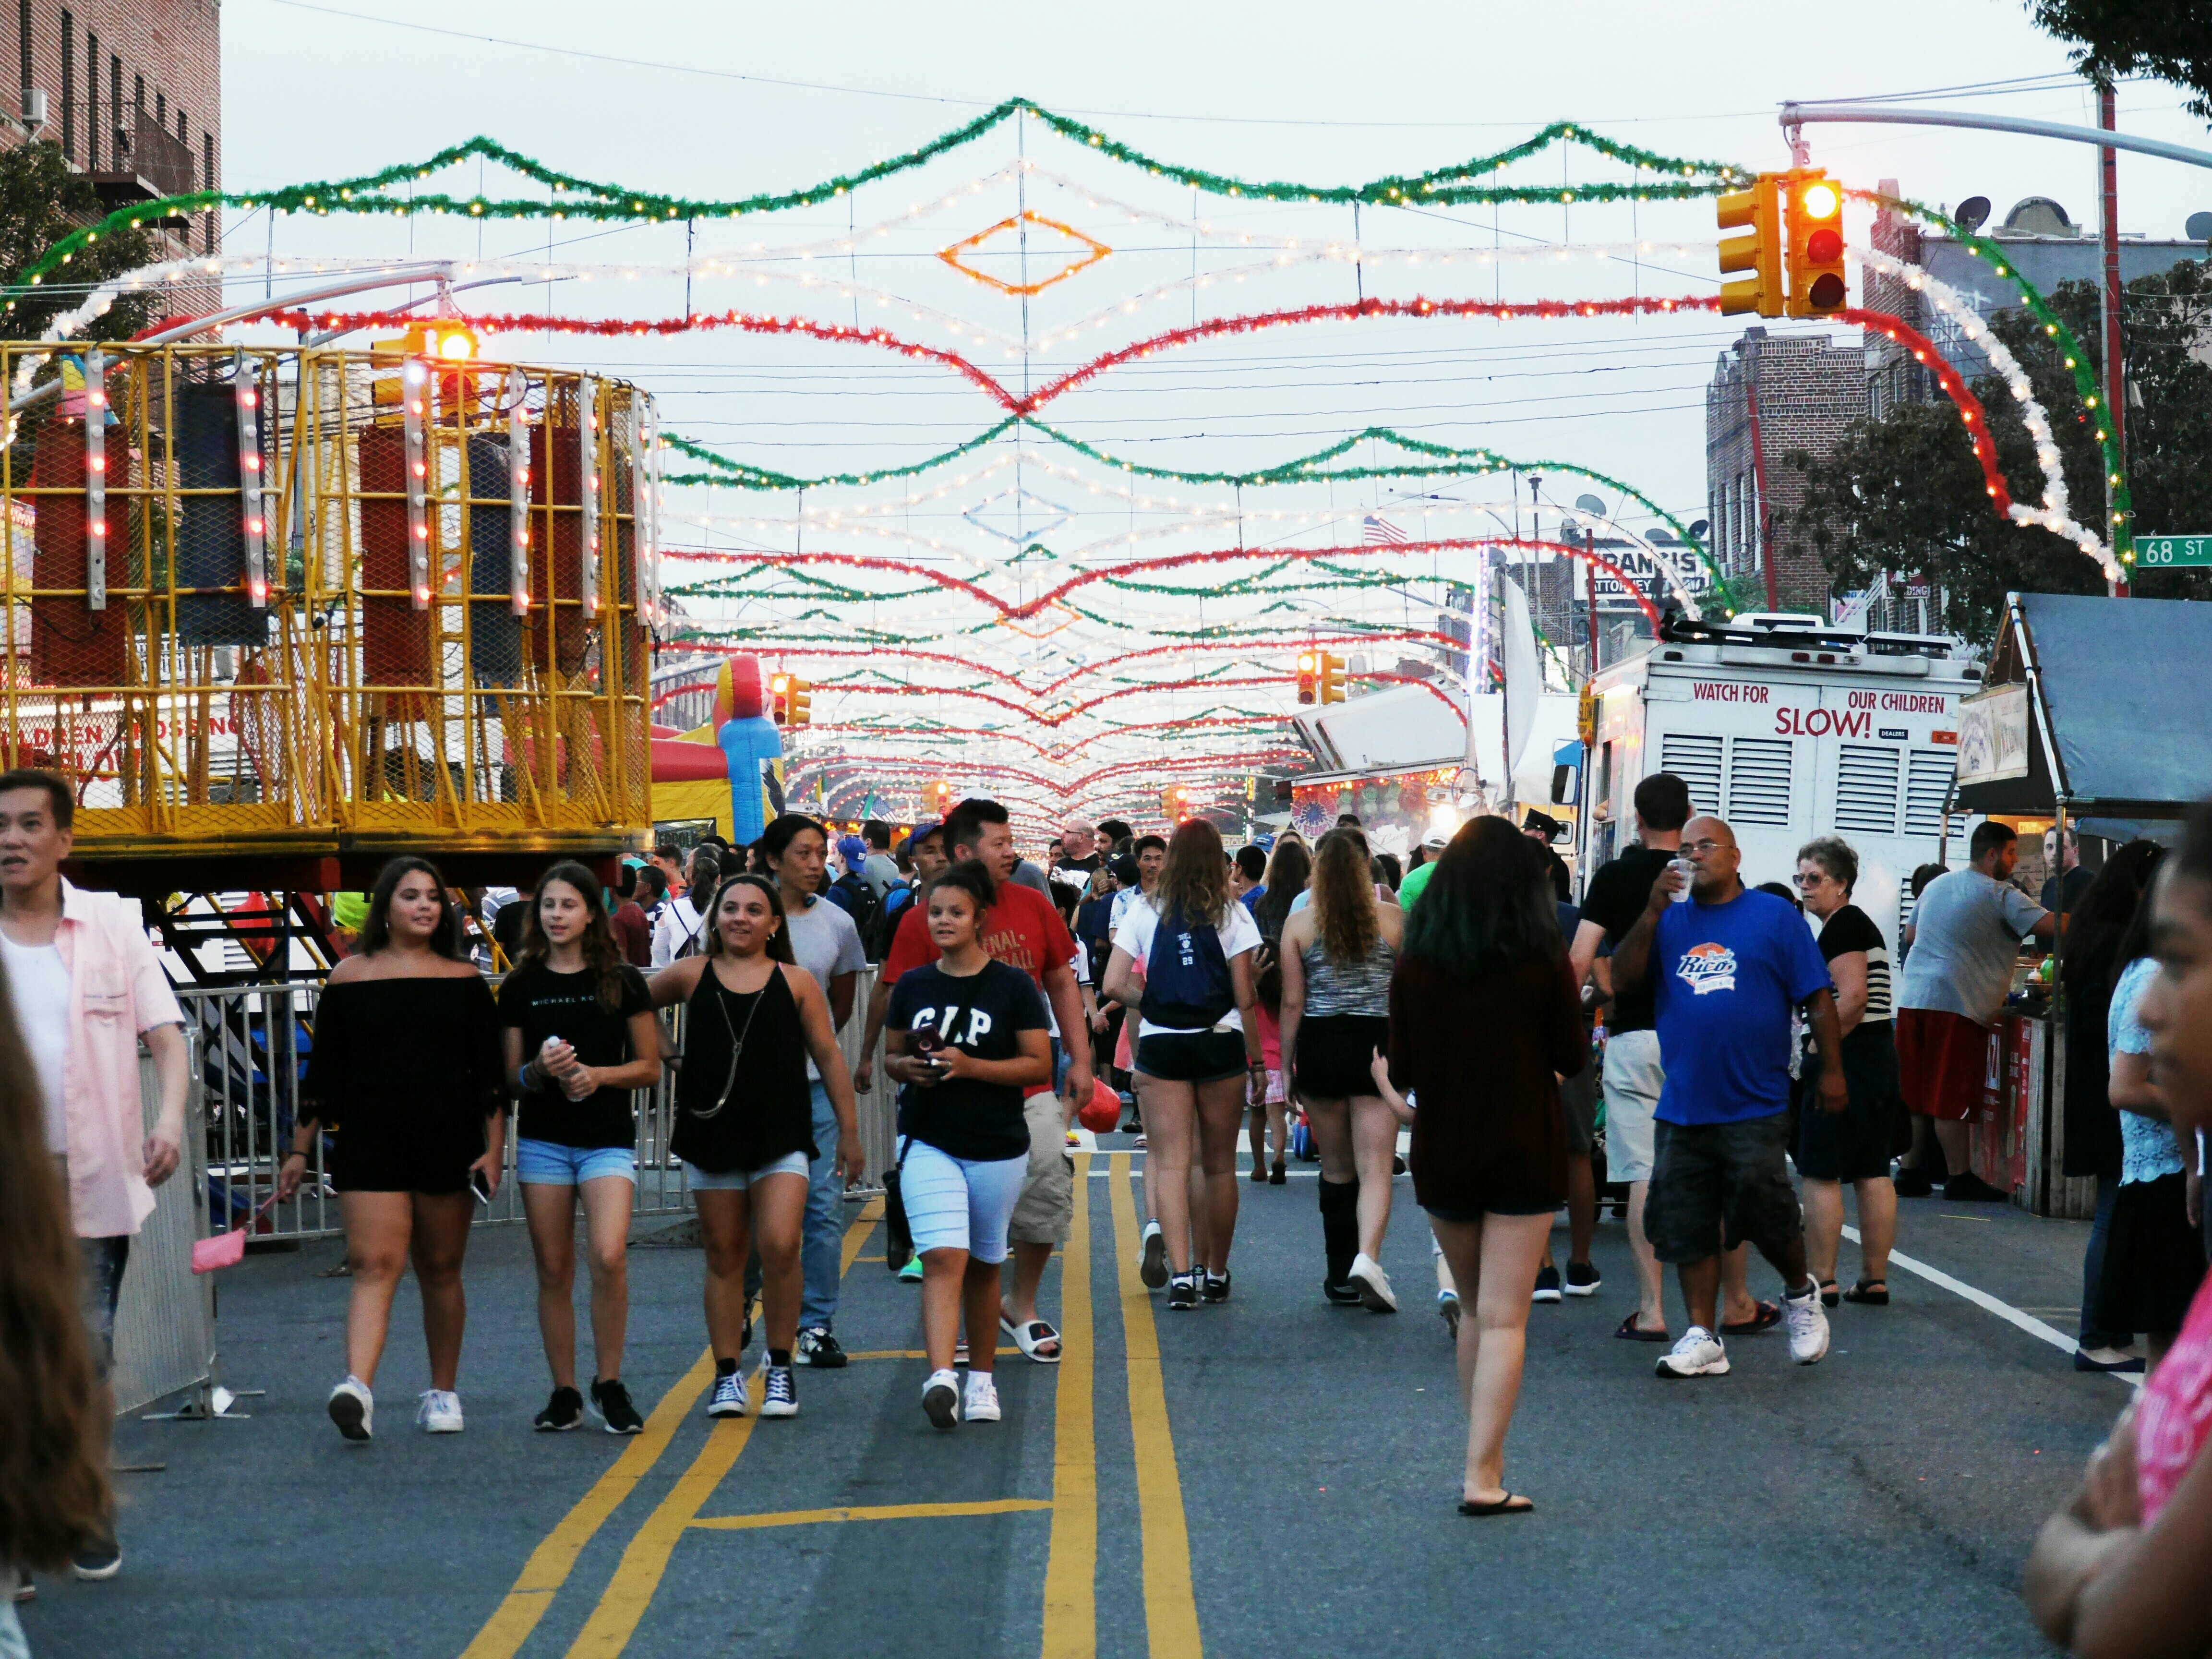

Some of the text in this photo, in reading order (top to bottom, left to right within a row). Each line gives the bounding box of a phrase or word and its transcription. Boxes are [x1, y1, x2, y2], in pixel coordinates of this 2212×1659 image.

[2146, 540, 2205, 564] 68 ST
[1587, 552, 1696, 574] RANIS
[1588, 580, 1651, 592] TTOREY
[1887, 586, 1927, 596] DING
[1694, 683, 1768, 704] WATCH FOR
[1848, 691, 1945, 714] OUR CHILDREN
[1774, 707, 1871, 739] SLOW!
[532, 998, 576, 1006] MICHAEL
